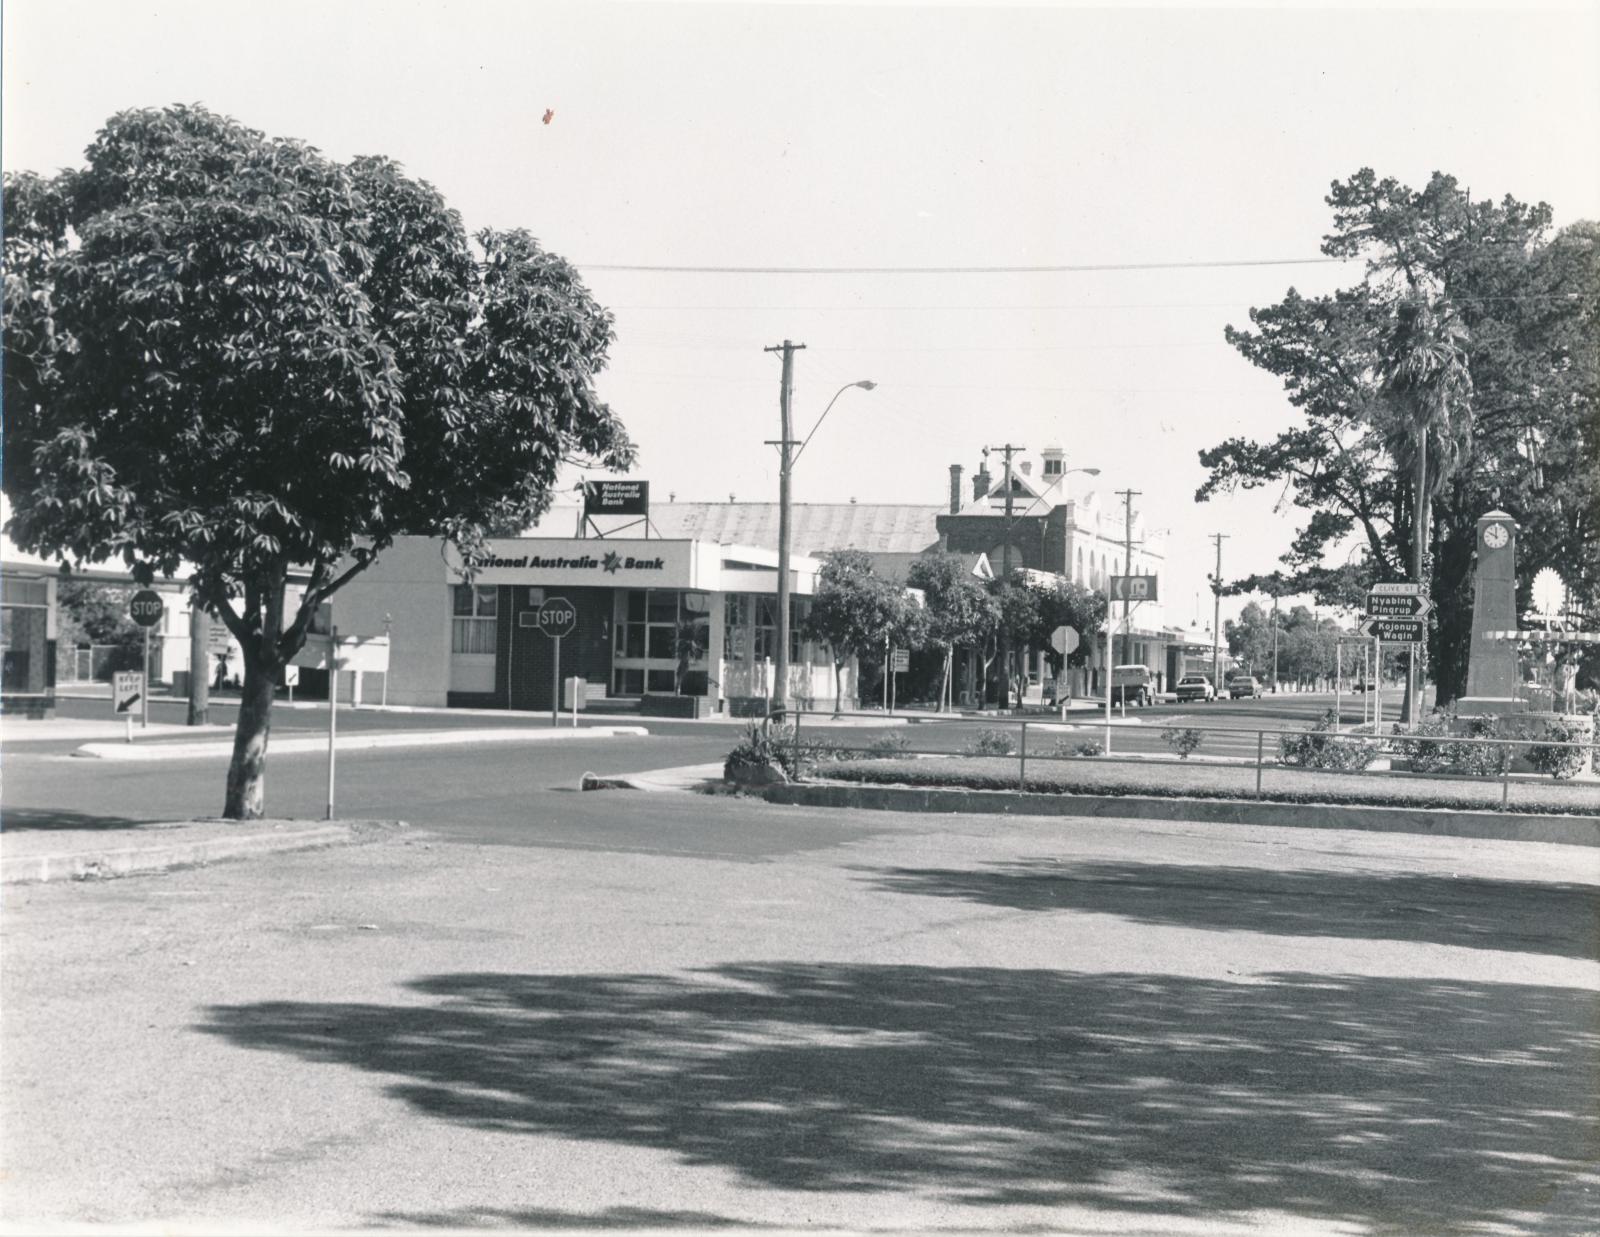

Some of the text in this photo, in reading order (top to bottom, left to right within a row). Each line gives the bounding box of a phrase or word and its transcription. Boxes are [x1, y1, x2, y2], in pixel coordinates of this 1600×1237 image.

[602, 483, 640, 491] National
[602, 498, 625, 506] Bank
[529, 555, 599, 569] Australia
[624, 557, 665, 570] Bank
[1371, 597, 1412, 606] Nyabing
[132, 601, 162, 615] STOP
[1372, 606, 1411, 615] Pingrup
[541, 609, 573, 625] STOP
[1378, 623, 1418, 632] Kojonup
[1383, 632, 1413, 641] Wagin
[119, 675, 141, 683] KEEP
[119, 684, 139, 692] LEFT
